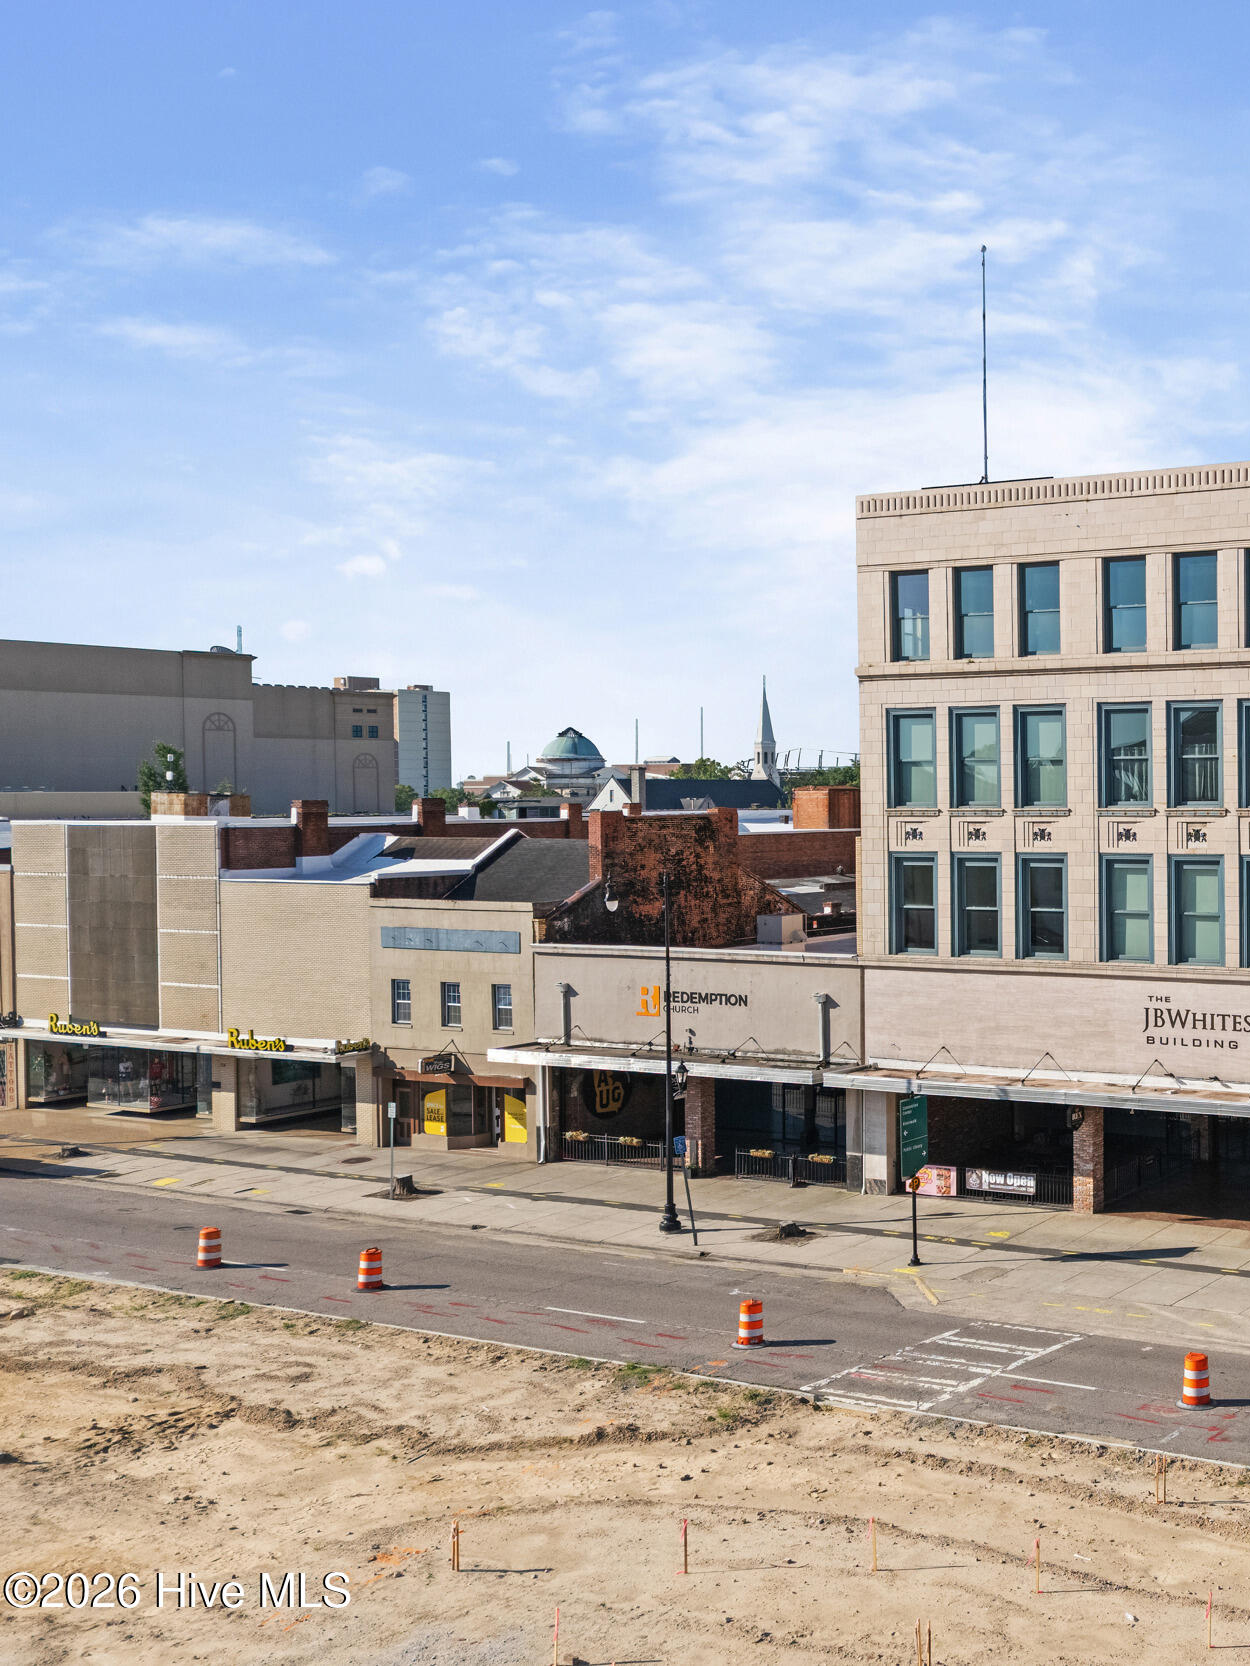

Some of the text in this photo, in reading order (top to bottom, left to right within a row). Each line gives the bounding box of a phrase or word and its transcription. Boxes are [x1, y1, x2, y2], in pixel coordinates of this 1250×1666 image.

[663, 990, 748, 1007] REDEMPTION
[1147, 995, 1171, 1003] THE
[48, 1013, 100, 1036] Ruben's
[227, 1028, 286, 1051] Ruben's
[1146, 1035, 1239, 1049] BUILDING
[425, 1062, 451, 1072] WIGS
[426, 1107, 440, 1115] SALE
[426, 1114, 445, 1122] LEASE
[982, 1170, 1034, 1187] Now Open
